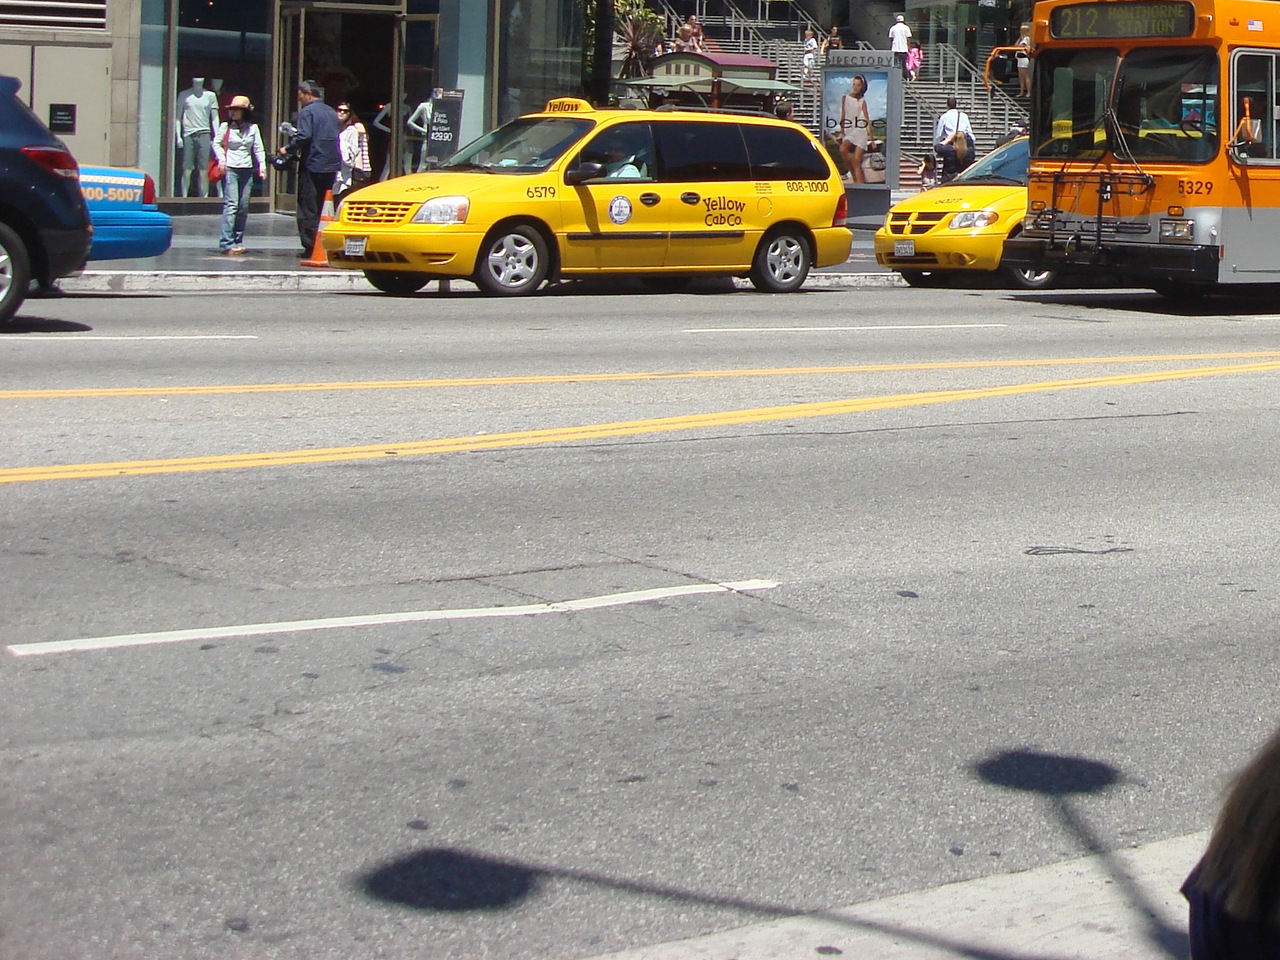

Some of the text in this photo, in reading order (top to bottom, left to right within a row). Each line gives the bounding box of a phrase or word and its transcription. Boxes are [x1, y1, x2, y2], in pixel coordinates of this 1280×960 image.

[1107, 4, 1186, 21] HAWTHORNE
[1060, 7, 1099, 37] 212
[1116, 19, 1176, 35] STATION
[826, 56, 893, 66] DIRECTORY
[547, 102, 580, 112] Yellow
[826, 117, 886, 128] bebe
[431, 132, 453, 142] $29.90
[526, 187, 556, 198] 6579
[786, 181, 829, 193] 808-1000
[1178, 180, 1214, 196] 5329
[703, 197, 746, 213] Yellow
[705, 214, 743, 227] Cab Co.
